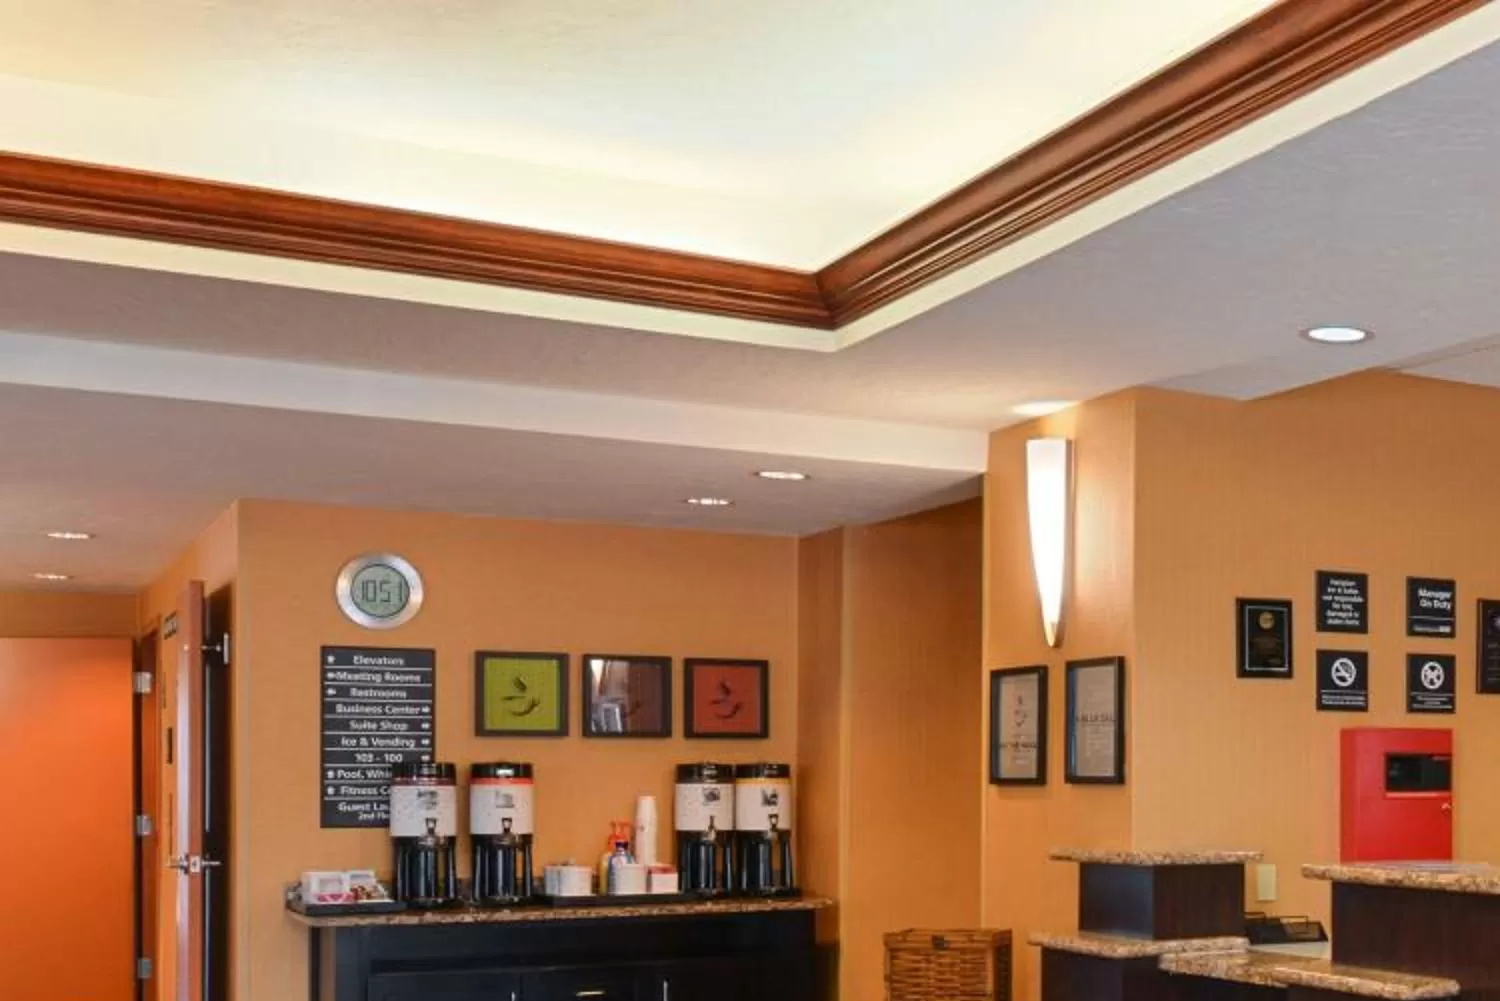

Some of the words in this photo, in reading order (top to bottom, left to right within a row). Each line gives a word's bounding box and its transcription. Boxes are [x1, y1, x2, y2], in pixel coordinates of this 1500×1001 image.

[1418, 588, 1452, 600] Manager
[1433, 600, 1452, 611] Duty
[353, 655, 405, 665] Elevators
[336, 672, 382, 682] Meeting
[384, 672, 421, 682] Rooms
[350, 688, 407, 698] Restrooms
[336, 704, 382, 713] Business
[385, 705, 420, 714] Center
[350, 720, 377, 730] Suite
[380, 720, 408, 731] Shop
[341, 736, 357, 746] Ice
[360, 738, 368, 746] &
[371, 737, 415, 748] Vending
[341, 786, 378, 795] Fitness
[337, 802, 371, 812] Guest
